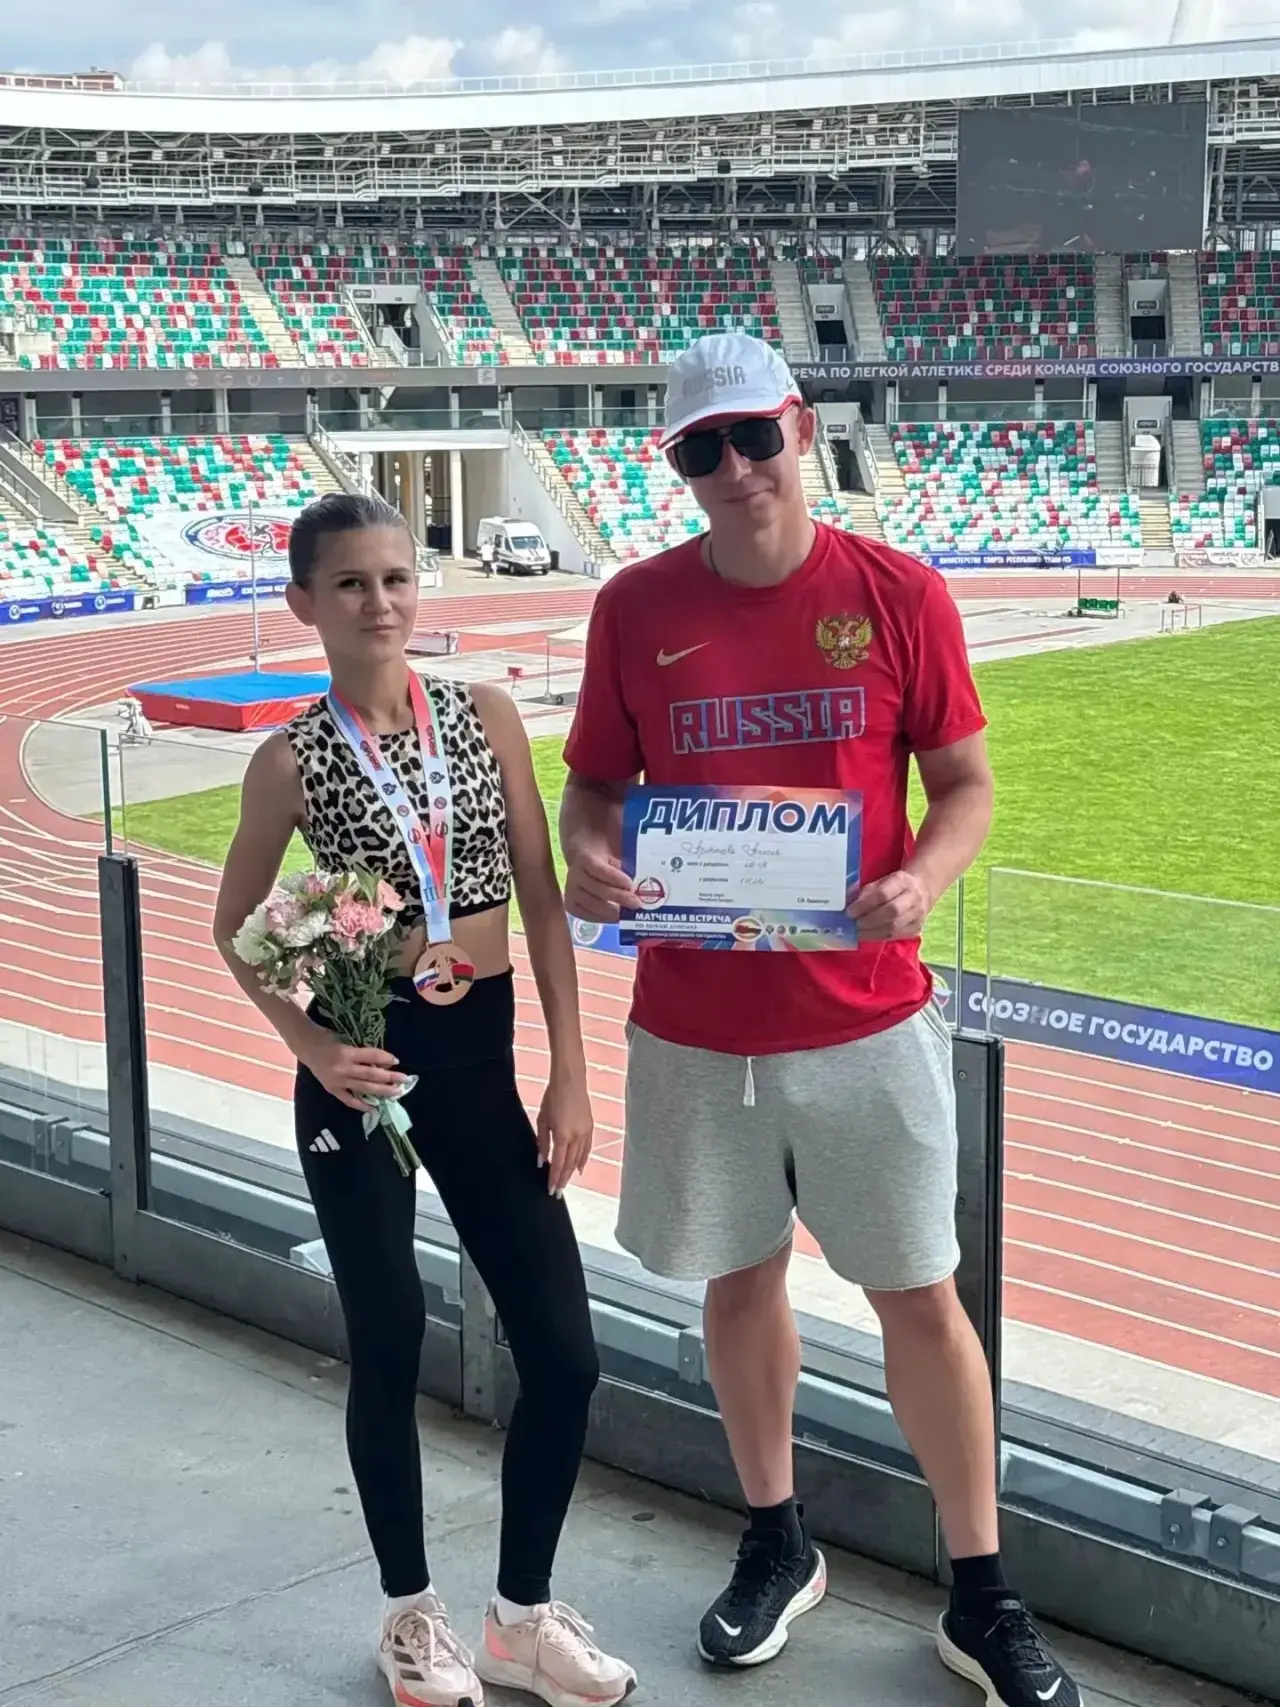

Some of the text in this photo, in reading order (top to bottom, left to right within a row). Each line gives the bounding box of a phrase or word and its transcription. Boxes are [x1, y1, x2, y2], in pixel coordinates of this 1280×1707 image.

[681, 366, 747, 397] RUSSIA
[790, 367, 827, 379] РЕЧА
[830, 367, 850, 378] ПО
[853, 364, 909, 378] ЛЕГКОЙ
[911, 365, 983, 377] АТЛЕТИКЕ
[985, 364, 1032, 377] СРЕДИ
[1035, 363, 1097, 376] КОМАНД
[1100, 362, 1182, 374] СОЮЗНОГО
[670, 687, 865, 754] RUSSIA
[639, 798, 849, 835] ДИПЛОМ
[635, 912, 731, 923] МАТЧЕВАЯ ВСТРЕЧА
[1088, 1016, 1274, 1072] ГОСУДАРСТВО
